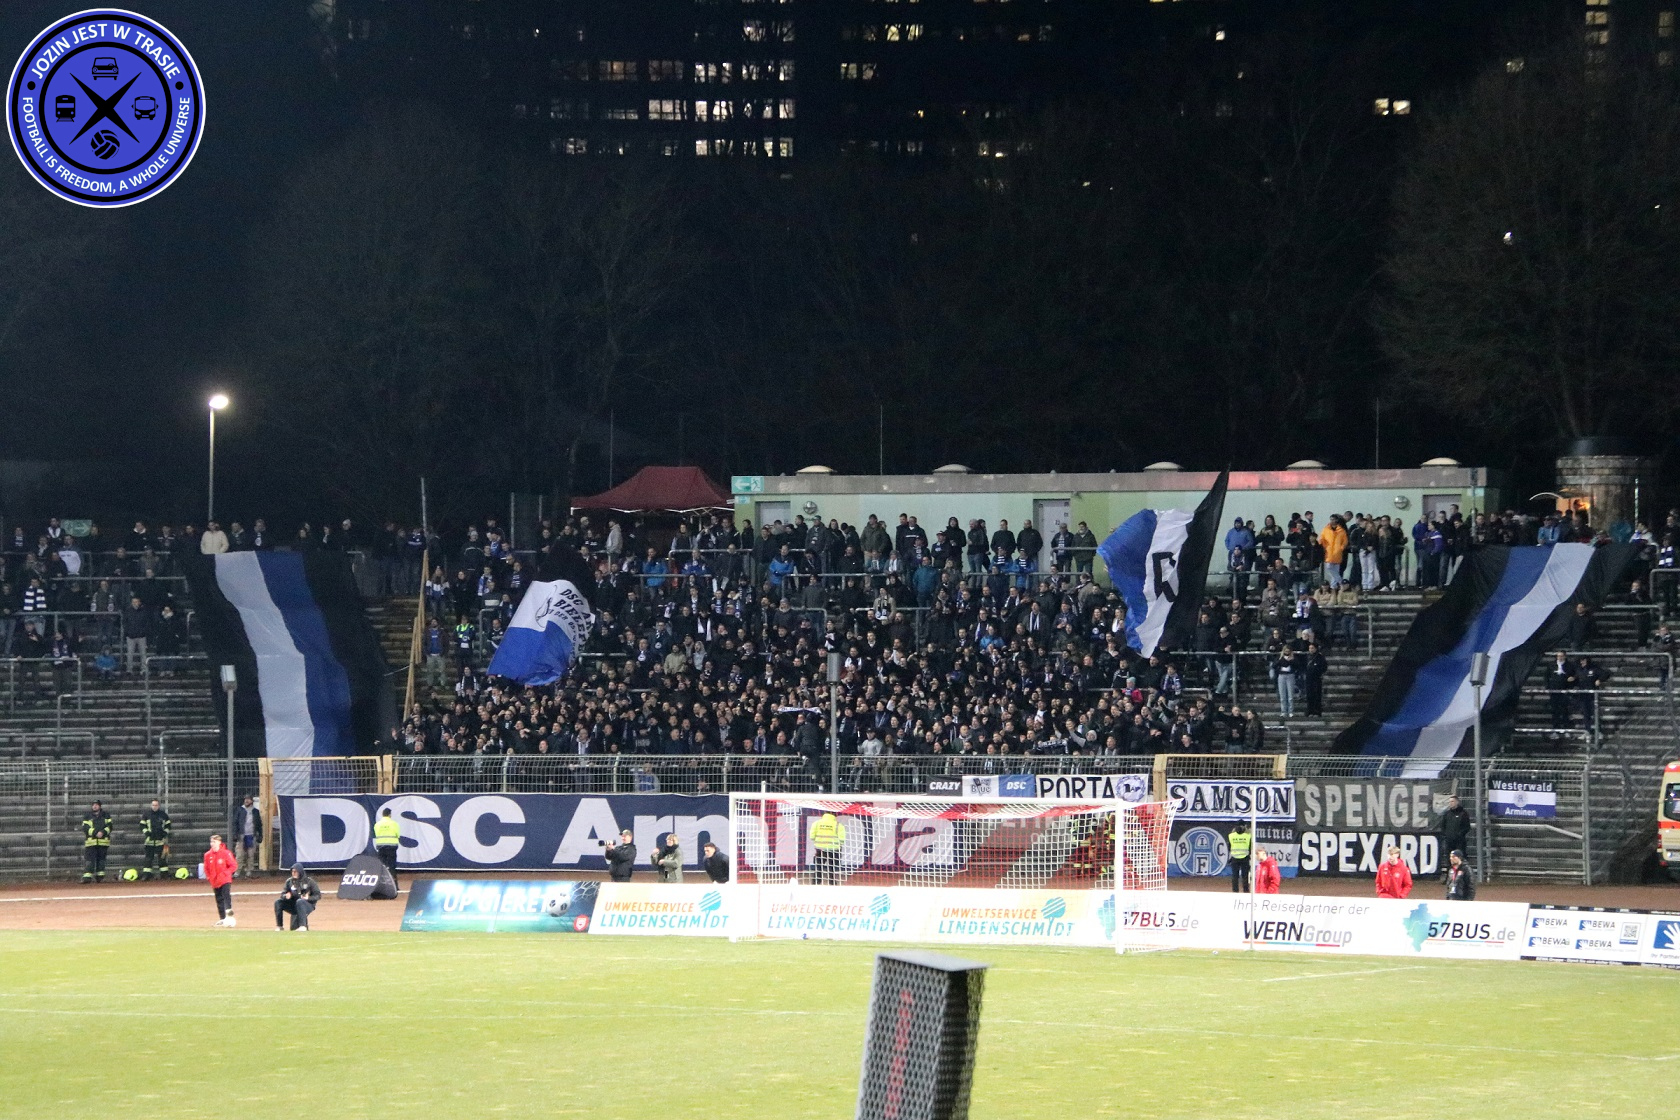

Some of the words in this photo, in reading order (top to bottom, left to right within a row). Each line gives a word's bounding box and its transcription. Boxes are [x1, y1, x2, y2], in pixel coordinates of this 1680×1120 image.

[929, 781, 961, 791] CRAZY
[1006, 781, 1027, 791] DSC
[1039, 777, 1115, 799] PORTA
[1492, 780, 1552, 792] Westerwald
[1170, 785, 1292, 815] SAMSON
[1304, 784, 1430, 828] SPENGE
[1505, 806, 1537, 817] Arminen
[294, 795, 526, 864] DSC
[1256, 826, 1293, 840] minia
[1301, 831, 1439, 875] SPEXARD
[604, 901, 694, 913] UMWELTSERVICE
[771, 903, 865, 916] UMWELTSERVICE
[1233, 899, 1258, 911] Ihre
[1261, 900, 1345, 915] Reisepartner
[1347, 904, 1371, 915] der
[942, 908, 1038, 920] UMWELTSERVICE
[600, 913, 730, 929] LINDENSCHMIDT
[767, 915, 901, 933] LINDENSCHMIDT
[1545, 918, 1568, 927] BEWA
[1592, 920, 1616, 929] BEWA
[938, 920, 1076, 937] LINDENSCHMIDT
[1427, 921, 1517, 942] 57BUS.de
[1542, 937, 1566, 946] BEWA
[1588, 939, 1612, 948] BEWA
